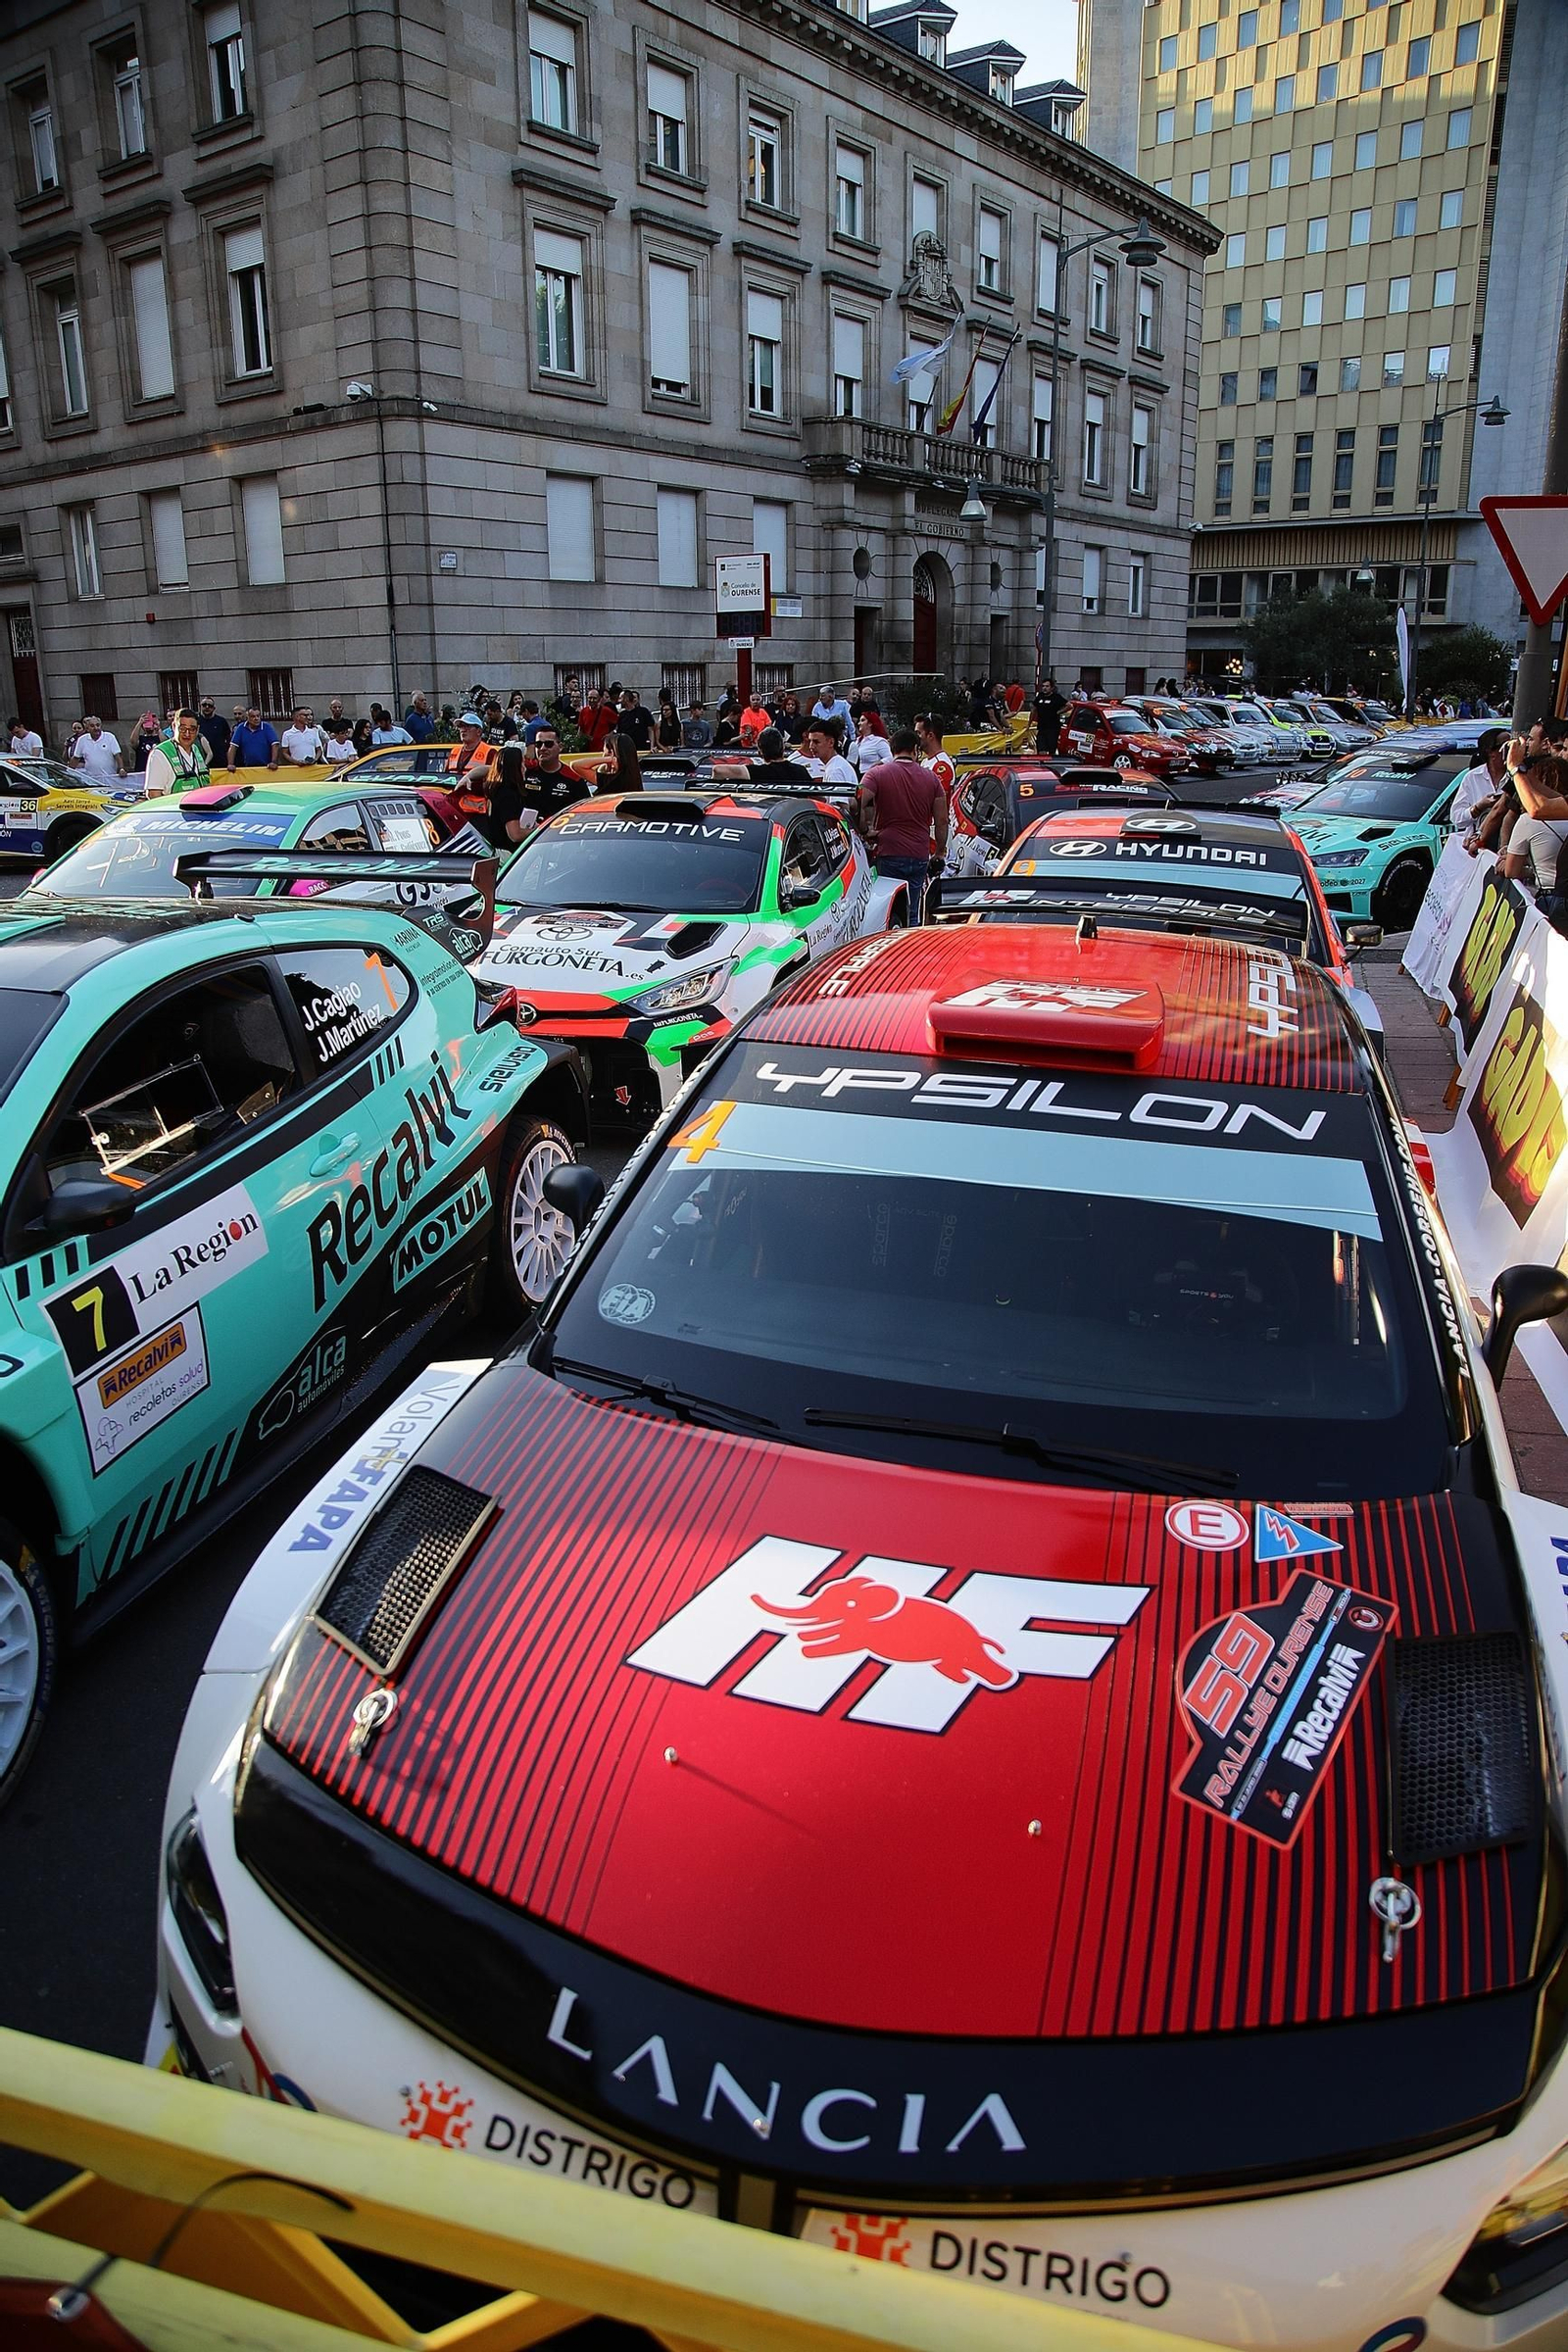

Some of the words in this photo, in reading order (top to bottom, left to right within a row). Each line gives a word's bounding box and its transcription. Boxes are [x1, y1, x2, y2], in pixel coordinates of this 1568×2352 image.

[927, 524, 964, 537] GOBIERNO
[1019, 784, 1035, 797] 5
[1093, 785, 1149, 795] RACING
[1372, 771, 1417, 780] Recalvi
[21, 801, 36, 811] 36
[142, 820, 286, 836] MICHELIN
[550, 813, 575, 829] 6
[423, 818, 440, 845] 8
[559, 821, 745, 842] CARMOTIVE
[1115, 842, 1266, 865] HYUNDAI
[308, 882, 327, 895] RACC
[1106, 892, 1276, 917] YPSILON
[451, 931, 472, 955] alca
[500, 944, 571, 955] Comauto
[577, 947, 603, 956] Sur
[302, 981, 363, 1031] J.Cagiao
[318, 1003, 383, 1063] J.Martínez
[756, 1062, 1327, 1141] YPSILON
[666, 1101, 737, 1164] 4
[307, 1051, 471, 1314] Recalvi
[393, 1184, 490, 1279] MOTUL
[128, 1266, 173, 1304] La
[170, 1212, 259, 1277] Región
[72, 1286, 107, 1352] 7
[118, 1338, 169, 1392] Recalvi
[297, 1367, 345, 1413] automóviles
[298, 1336, 346, 1396] alca
[125, 1378, 165, 1408] HOSPITAL
[128, 1382, 176, 1426] recoletos
[178, 1361, 204, 1388] salud
[172, 1377, 206, 1406] OURENSE
[287, 1468, 388, 1552] FAPA
[1189, 1509, 1227, 1539] E
[625, 1534, 1152, 1733] HF
[1183, 1611, 1275, 1740] 59
[1202, 1687, 1278, 1809] RALLYE
[1262, 1580, 1334, 1696] OURENSE
[1295, 1655, 1359, 1747] Recalvi
[547, 1987, 1027, 2154] LANCIA
[483, 2115, 695, 2211] DISTRIGO
[931, 2230, 1170, 2309] DISTRIGO
